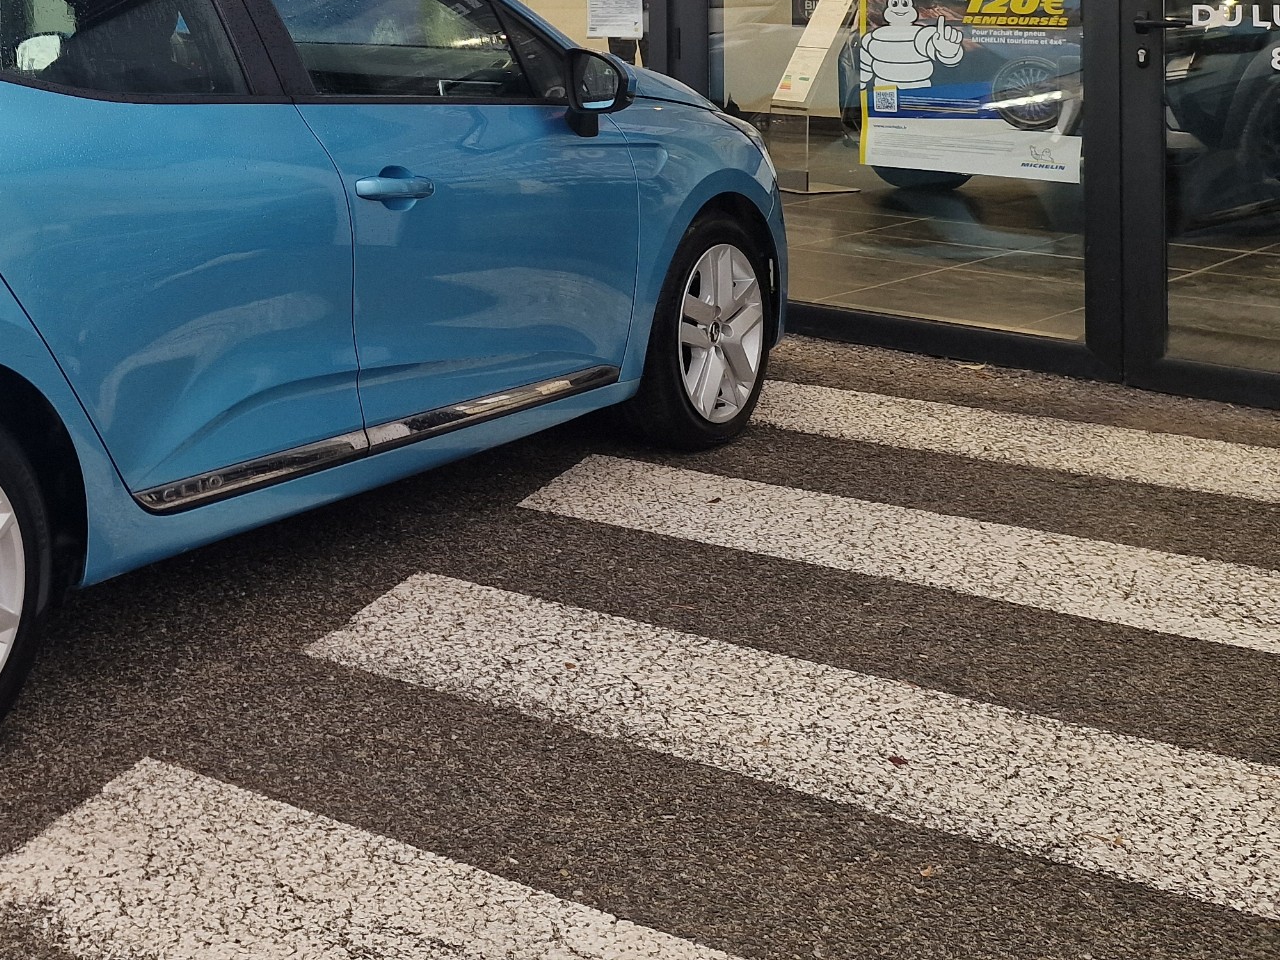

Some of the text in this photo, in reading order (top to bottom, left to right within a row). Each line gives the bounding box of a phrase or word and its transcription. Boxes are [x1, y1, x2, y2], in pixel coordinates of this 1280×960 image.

[1192, 4, 1242, 27] DU
[962, 15, 1068, 26] REMBOURSÉS
[1007, 37, 1039, 45] tourisme
[1021, 162, 1065, 170] MICHELIN
